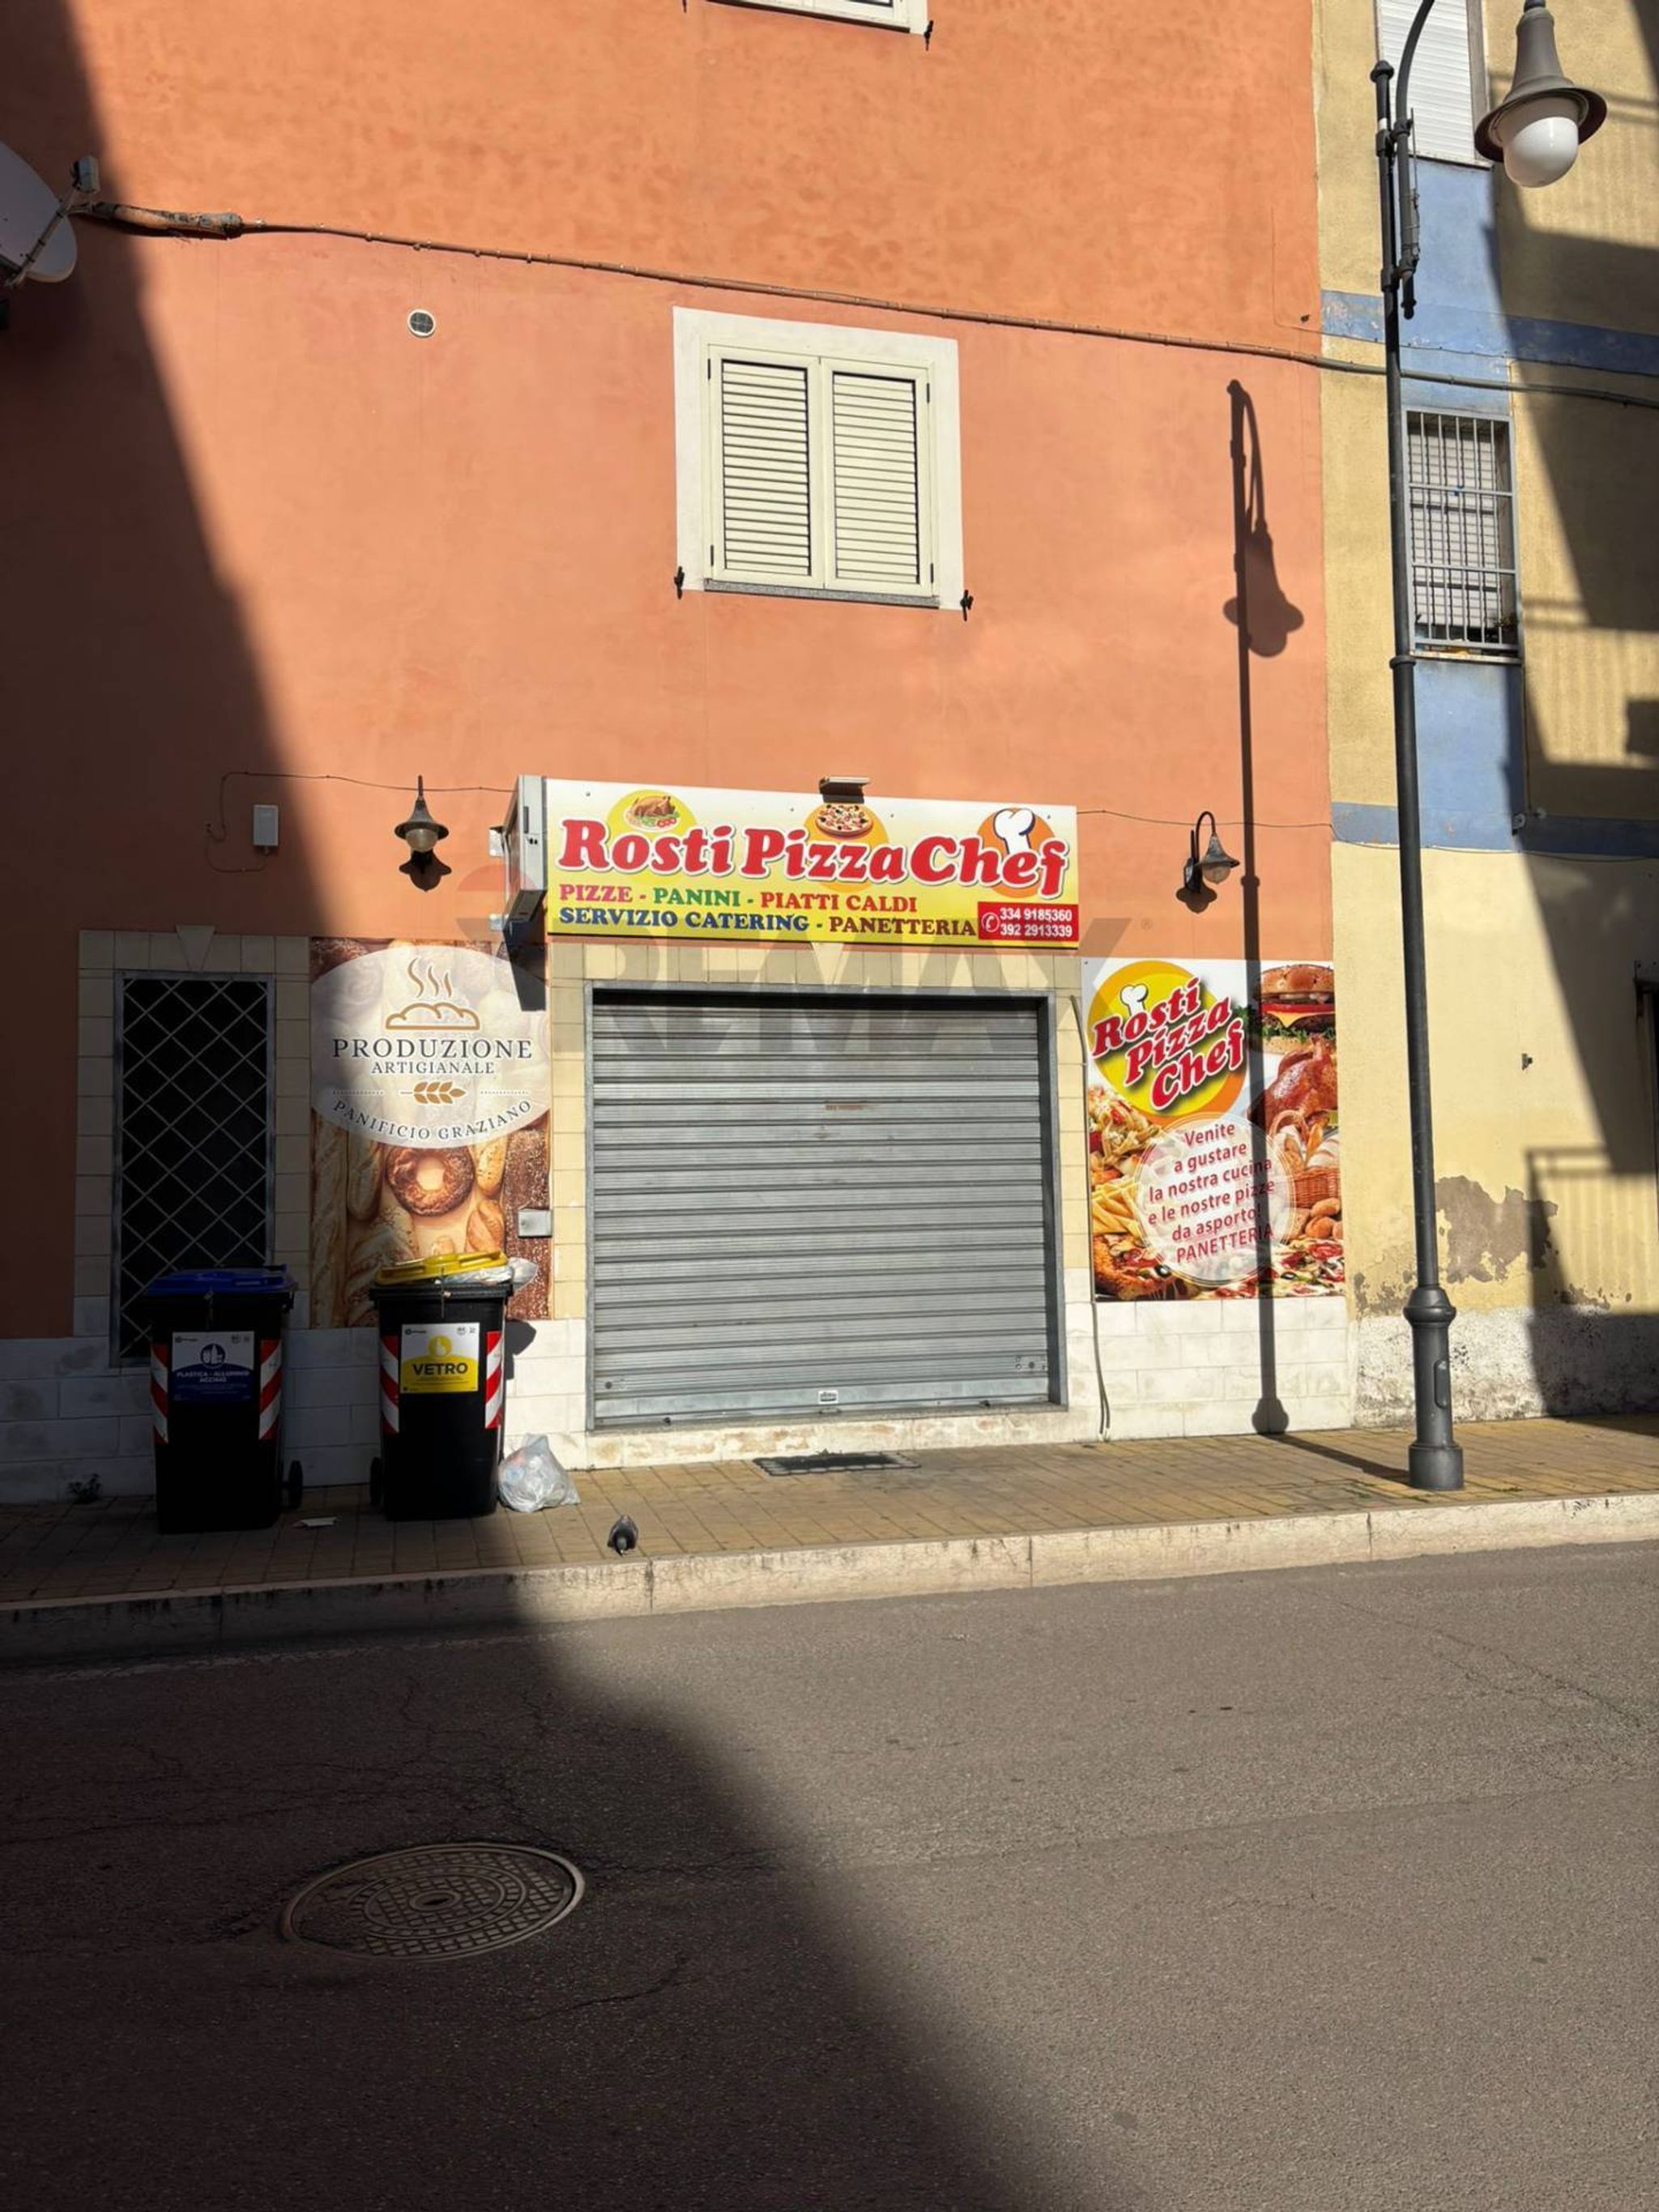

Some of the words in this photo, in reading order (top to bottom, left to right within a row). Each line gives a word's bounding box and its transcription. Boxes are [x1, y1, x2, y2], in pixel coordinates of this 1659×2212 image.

[558, 819, 734, 875] Rosti
[741, 828, 905, 884] Pizza
[911, 835, 1068, 897] Chef
[559, 884, 633, 903] PIZZE
[653, 888, 740, 906] PANINI
[760, 892, 839, 910] PIATTI
[846, 895, 917, 912] CALDI
[1000, 907, 1021, 920] 334
[1023, 908, 1073, 922] 9185360
[559, 907, 678, 927] SERVIZIO
[685, 912, 809, 931] CATERING
[830, 916, 977, 937] PANETTERIA
[1000, 923, 1021, 936] 392
[1024, 924, 1073, 937] 2913339
[1092, 977, 1201, 1059] Rosti
[332, 1038, 532, 1059] PRODUZIONE
[1124, 996, 1231, 1086] Pizza
[371, 1061, 495, 1074] ARTIGIANALE
[1151, 1017, 1245, 1110] Chef
[332, 1100, 430, 1140] PANIFICIO
[437, 1100, 531, 1140] GRAZIANO
[1184, 1123, 1235, 1146] Venite
[1175, 1160, 1183, 1173] a
[1188, 1143, 1247, 1173] gustare
[1149, 1187, 1162, 1202] la
[1168, 1174, 1218, 1197] nostra
[1222, 1158, 1272, 1181] cucina
[1148, 1213, 1157, 1225] e
[1162, 1205, 1175, 1221] le
[1180, 1191, 1230, 1217] nostre
[1235, 1180, 1274, 1205] pizze
[1172, 1225, 1191, 1241] da
[1196, 1203, 1261, 1234] asporto!
[1176, 1224, 1274, 1263] PANETTERIA
[412, 1362, 468, 1375] VETRO
